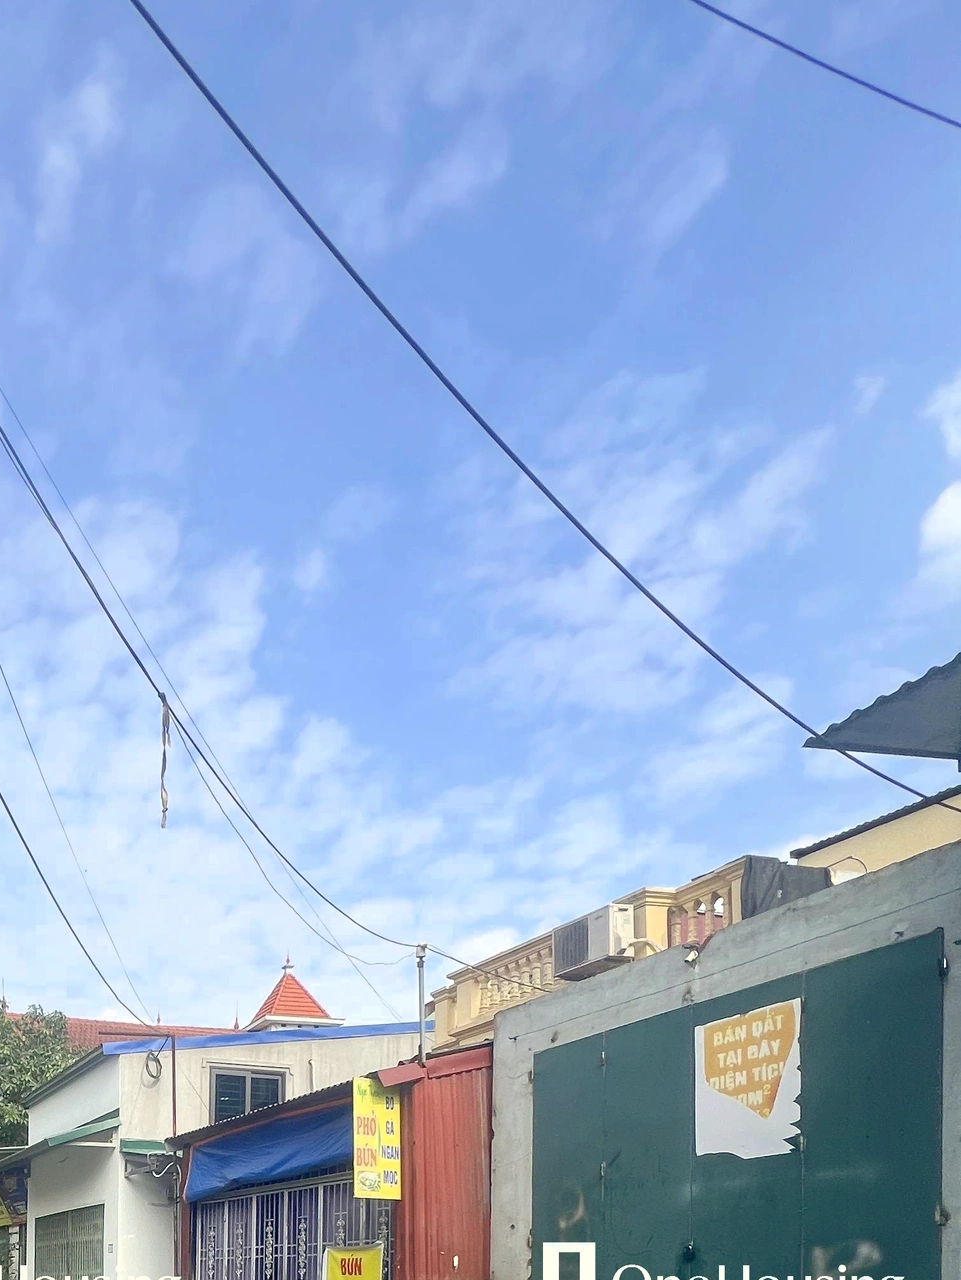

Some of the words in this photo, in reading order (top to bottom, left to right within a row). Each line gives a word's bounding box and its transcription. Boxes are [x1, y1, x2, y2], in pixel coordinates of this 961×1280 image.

[713, 1025, 748, 1047] BÁN
[751, 1009, 784, 1038] ĐẤT
[717, 1048, 742, 1069] TẠI
[356, 1109, 377, 1137] PHỞ
[356, 1143, 377, 1167] BÚN
[381, 1145, 400, 1160] NGAN
[383, 1170, 398, 1188] MỌC
[340, 1253, 362, 1276] BÚN
